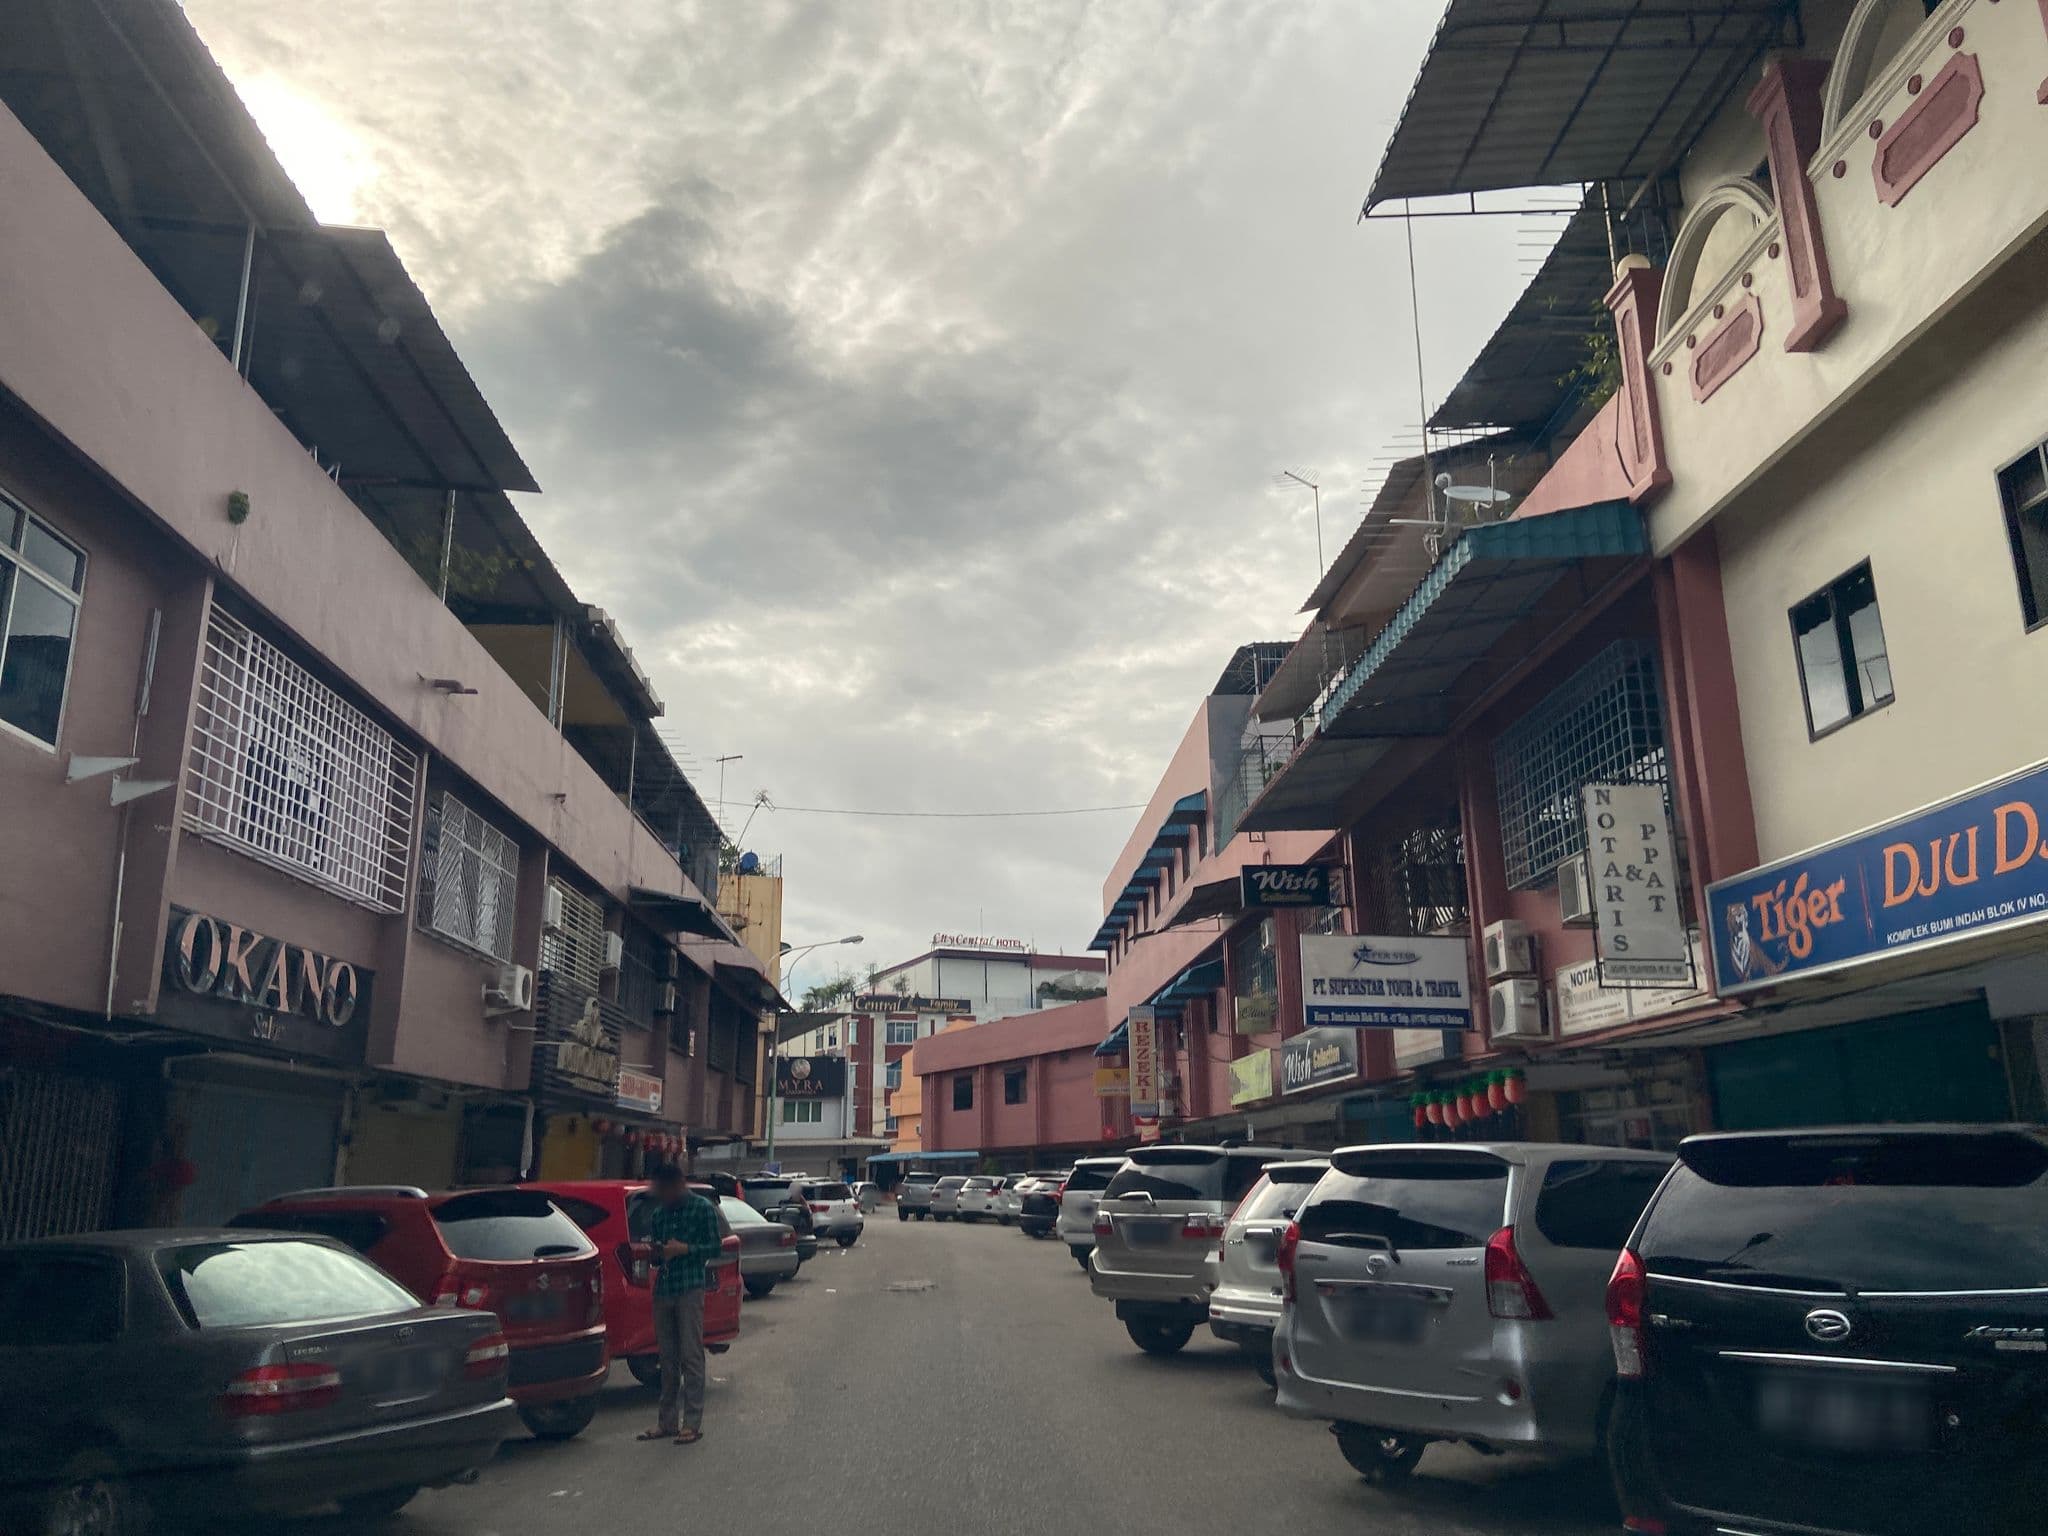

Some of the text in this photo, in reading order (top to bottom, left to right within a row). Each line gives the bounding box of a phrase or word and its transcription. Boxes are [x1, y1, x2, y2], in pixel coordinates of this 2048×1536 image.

[1251, 867, 1320, 890] Wish
[1594, 788, 1666, 952] NOTARIS & PPAT
[1882, 825, 1980, 909] DJU
[1751, 871, 1847, 958] Tiger
[1886, 924, 1929, 945] KOMPLEK
[1930, 917, 1954, 934] BUMI
[1955, 908, 1985, 927] INDAH
[1987, 900, 2015, 919] BLOK
[2017, 897, 2027, 911] IV
[996, 938, 1024, 948] HOTEL
[179, 913, 357, 1026] OKANO
[1312, 978, 1462, 998] PT. SUPERSTAR TOUR & TRAVEL
[855, 995, 901, 1011] Central
[1134, 1021, 1151, 1100] REZEKI
[1284, 1039, 1312, 1085] Wish
[778, 1079, 824, 1090] MYRA
